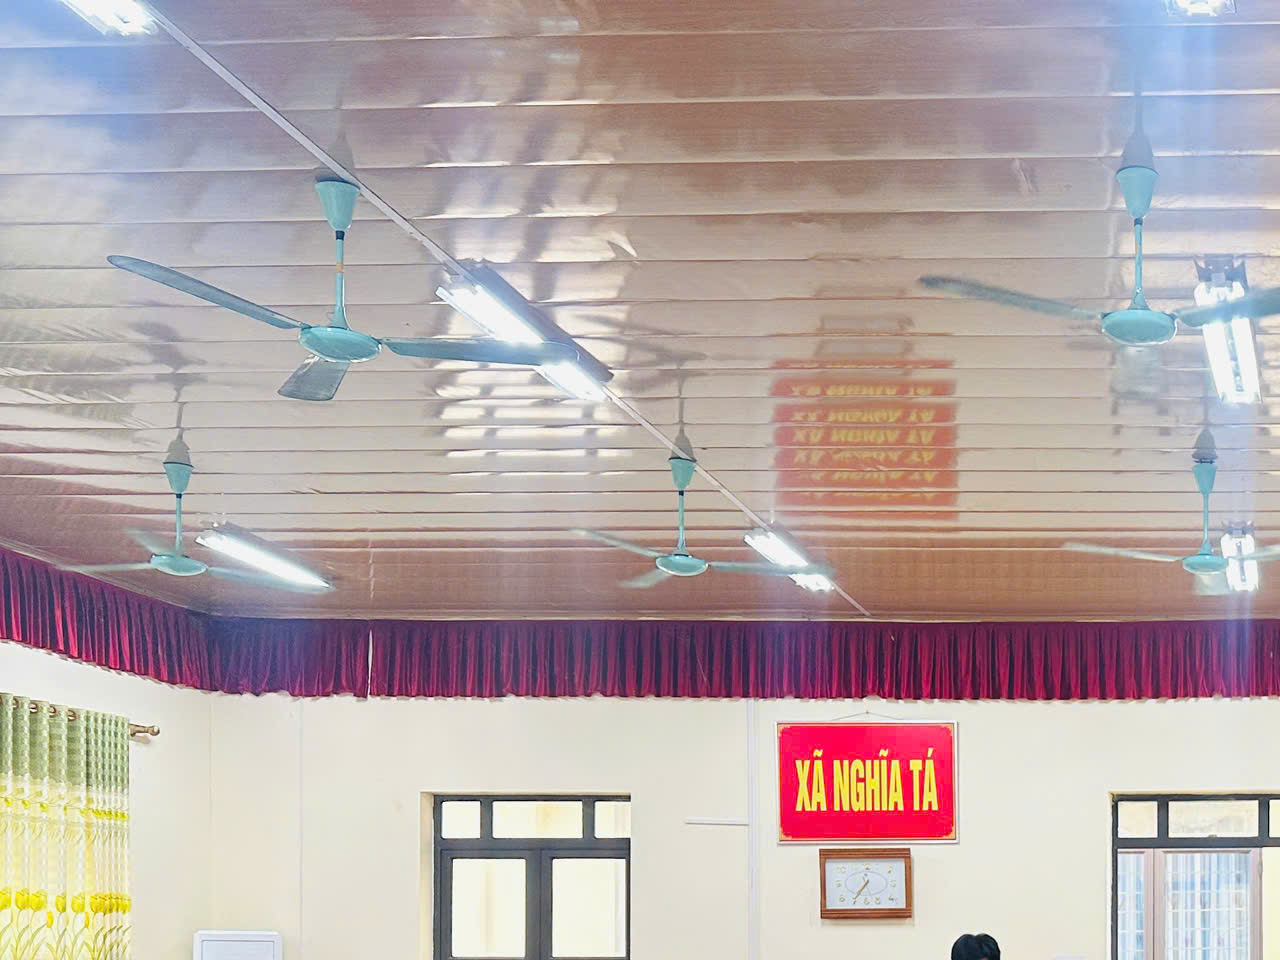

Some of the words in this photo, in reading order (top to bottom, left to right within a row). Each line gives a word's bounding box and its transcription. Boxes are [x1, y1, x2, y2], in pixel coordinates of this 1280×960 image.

[795, 748, 827, 812] XÃ
[833, 748, 904, 812] NGHĨA
[910, 747, 939, 811] TÁ
